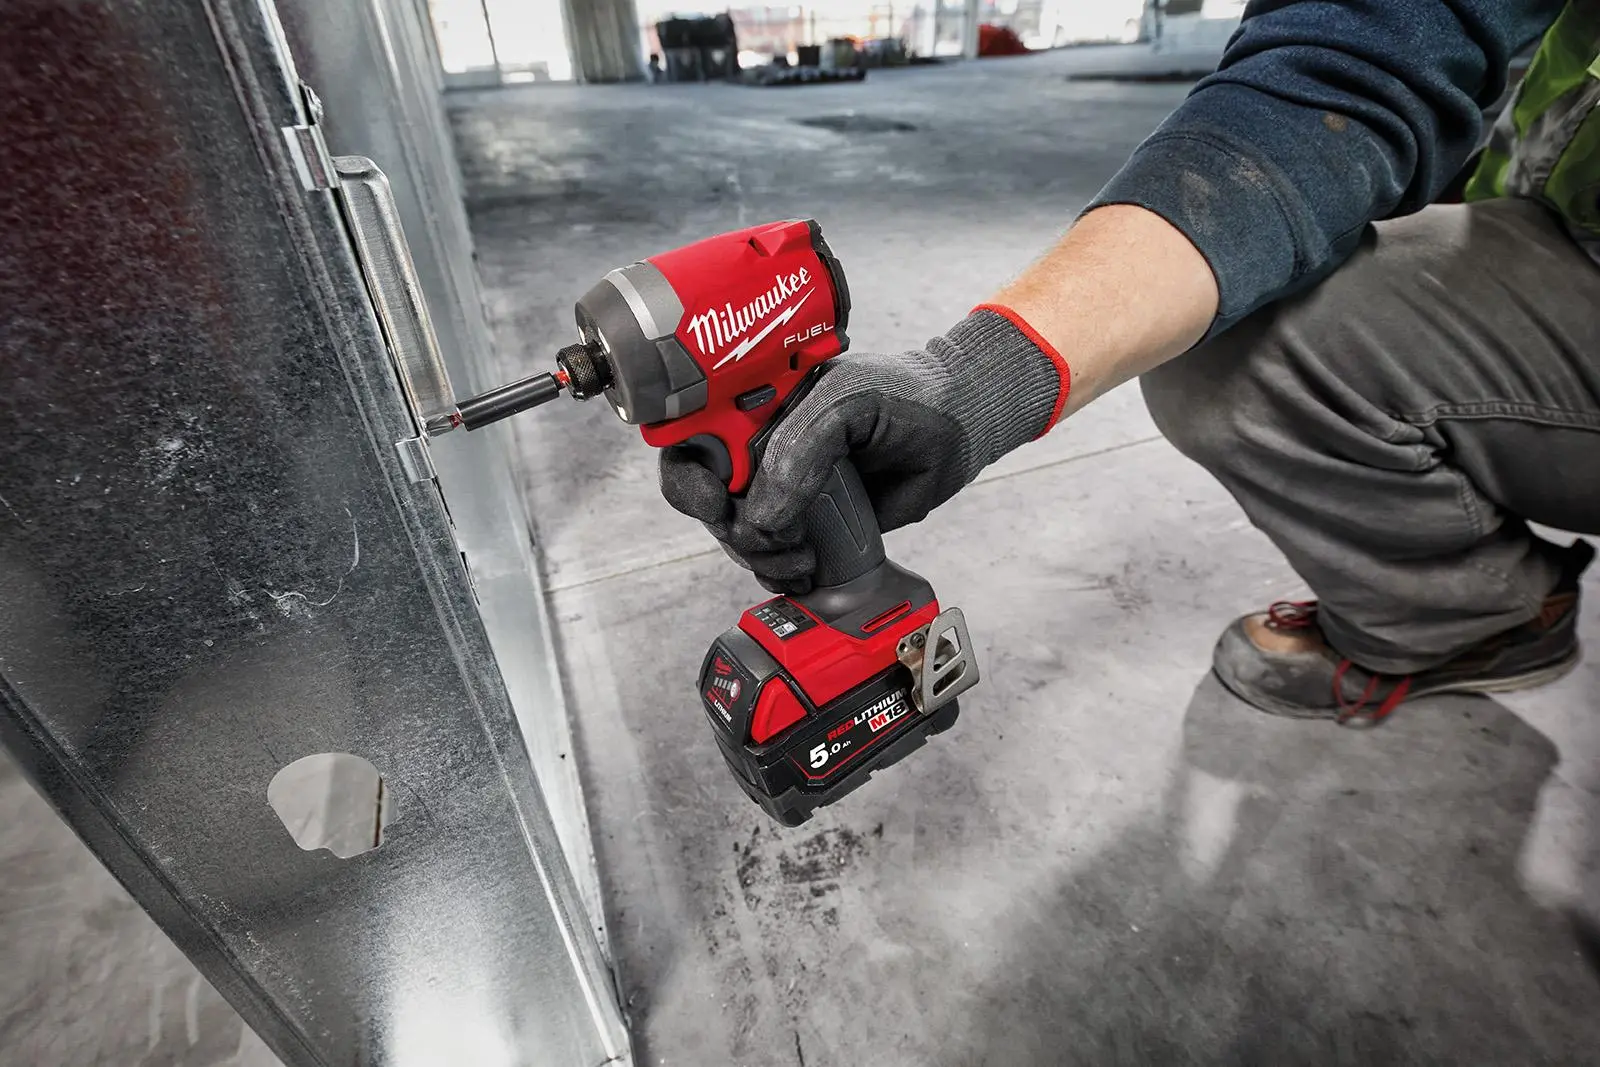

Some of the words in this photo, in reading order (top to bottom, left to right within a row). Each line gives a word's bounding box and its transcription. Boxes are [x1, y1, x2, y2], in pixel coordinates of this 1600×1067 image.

[687, 266, 811, 355] Milwaukee
[784, 321, 834, 348] FUEL
[827, 687, 908, 742] REDLITHIUM
[869, 702, 906, 731] M18
[809, 742, 841, 769] 5.0
